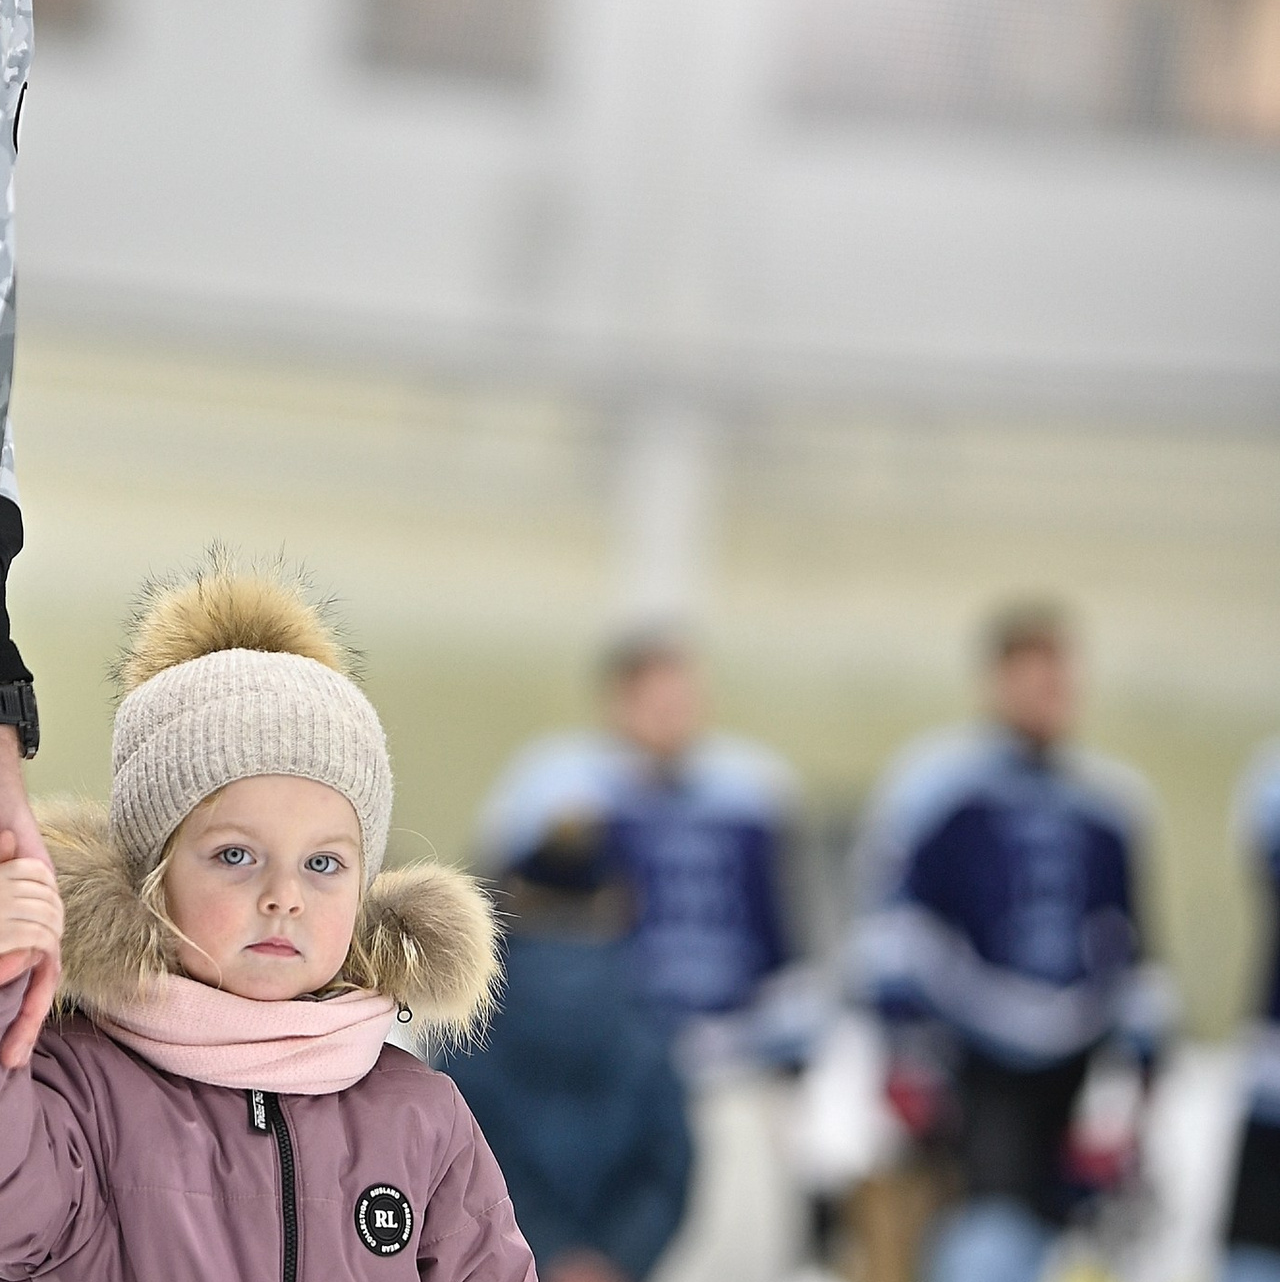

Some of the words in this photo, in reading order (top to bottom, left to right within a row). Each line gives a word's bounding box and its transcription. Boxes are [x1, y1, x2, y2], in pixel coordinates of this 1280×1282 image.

[358, 1199, 377, 1247] COLLECTION
[374, 1209, 398, 1229] RL
[401, 1202, 412, 1241] PREMIUM
[381, 1242, 401, 1253] WEAR
